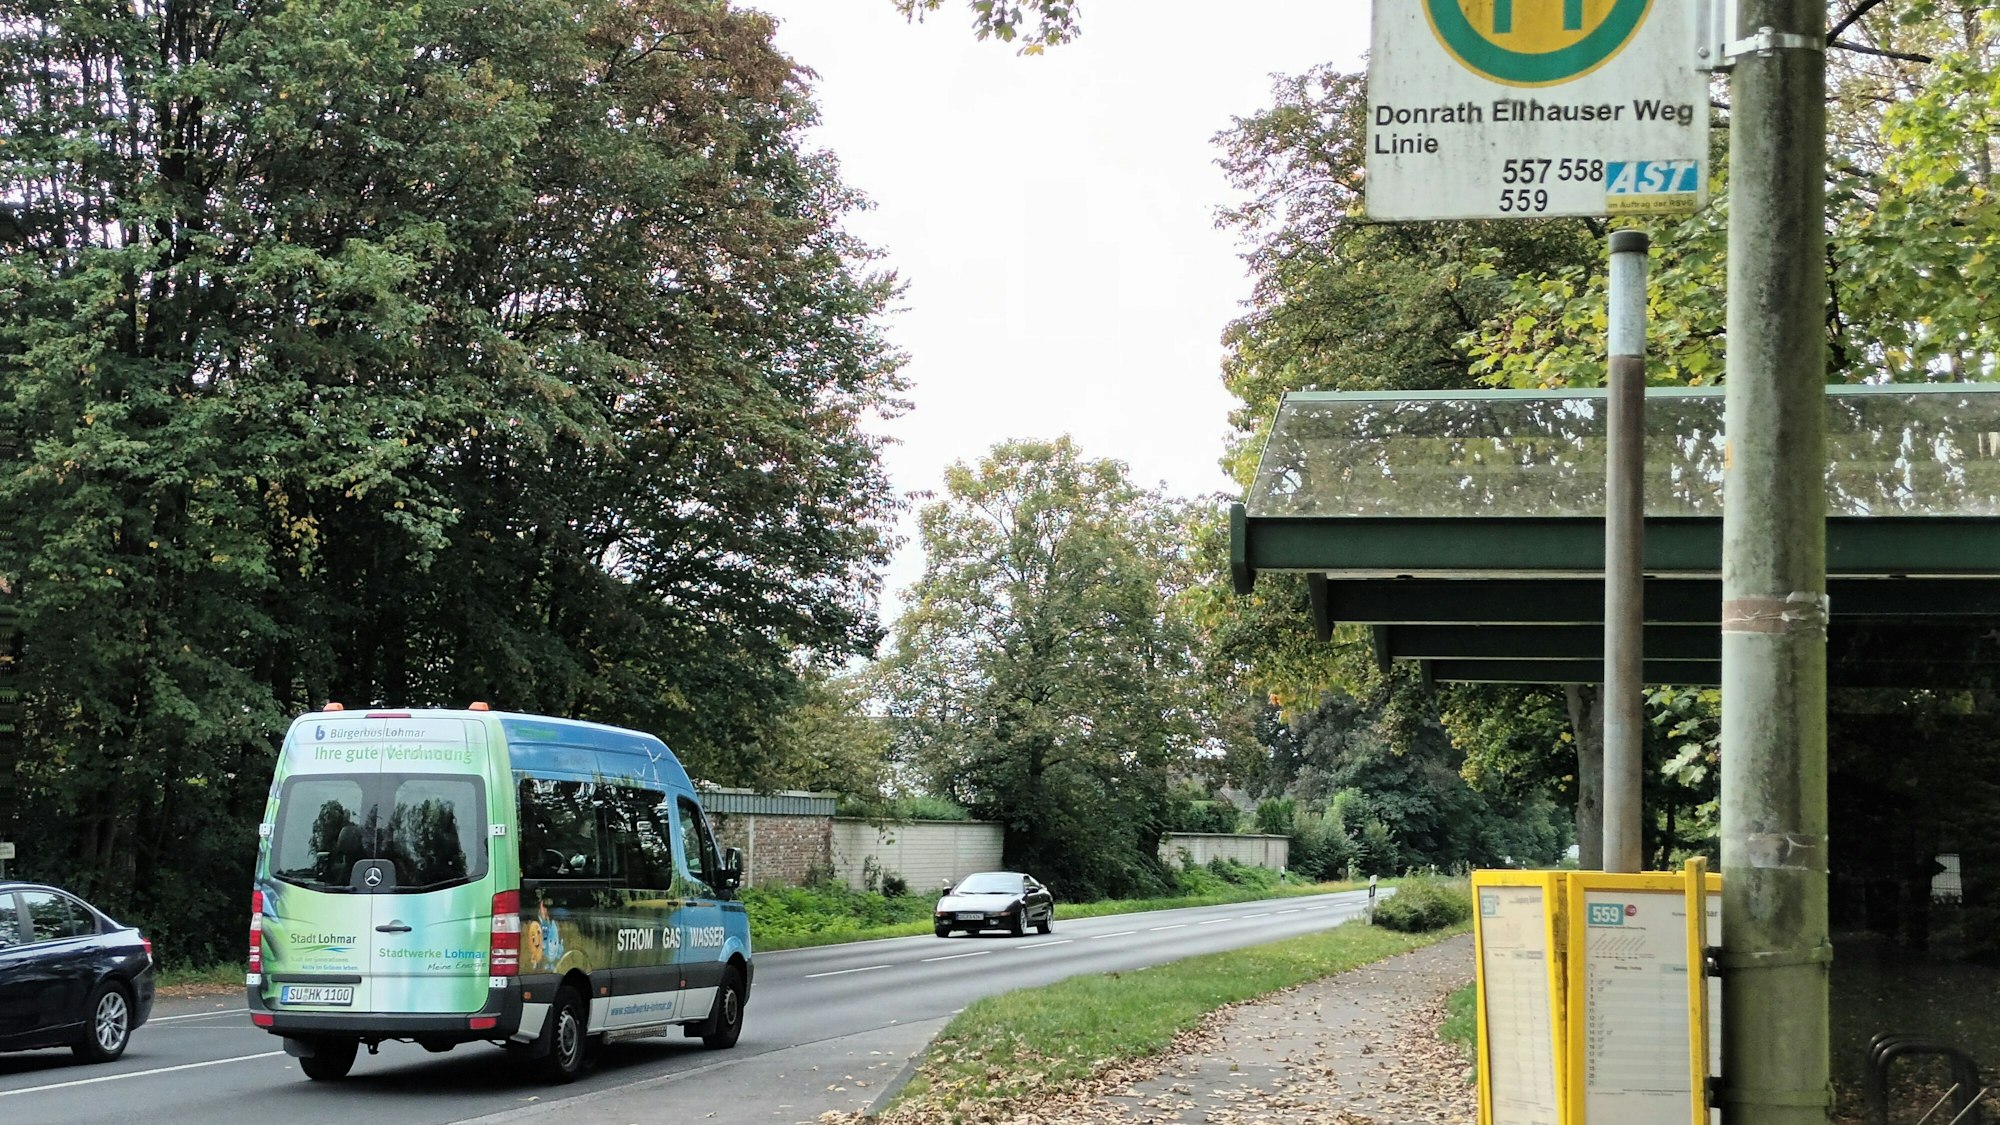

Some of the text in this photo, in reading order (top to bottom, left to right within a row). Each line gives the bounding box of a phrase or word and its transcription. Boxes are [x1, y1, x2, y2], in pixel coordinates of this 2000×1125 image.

[1375, 101, 1483, 126] Donrath
[1632, 99, 1695, 127] Weg
[1374, 132, 1439, 154] Linie
[1502, 157, 1604, 184] 557 558
[1607, 161, 1697, 194] AST
[1498, 188, 1548, 213] 559
[1620, 201, 1651, 209] Auftrag
[1653, 200, 1667, 208] der
[330, 728, 383, 740] Bürgerbus
[385, 727, 426, 738] Lohmar
[314, 746, 342, 760] Ihre
[345, 746, 378, 763] gute
[1592, 905, 1620, 923] 559
[290, 933, 357, 944] Stadt Lohmar
[617, 926, 725, 952] STROM GAS WASSER
[379, 947, 488, 959] Stadtwerke Lohmar
[426, 963, 452, 971] Meine
[289, 986, 350, 1001] SU HK 1100
